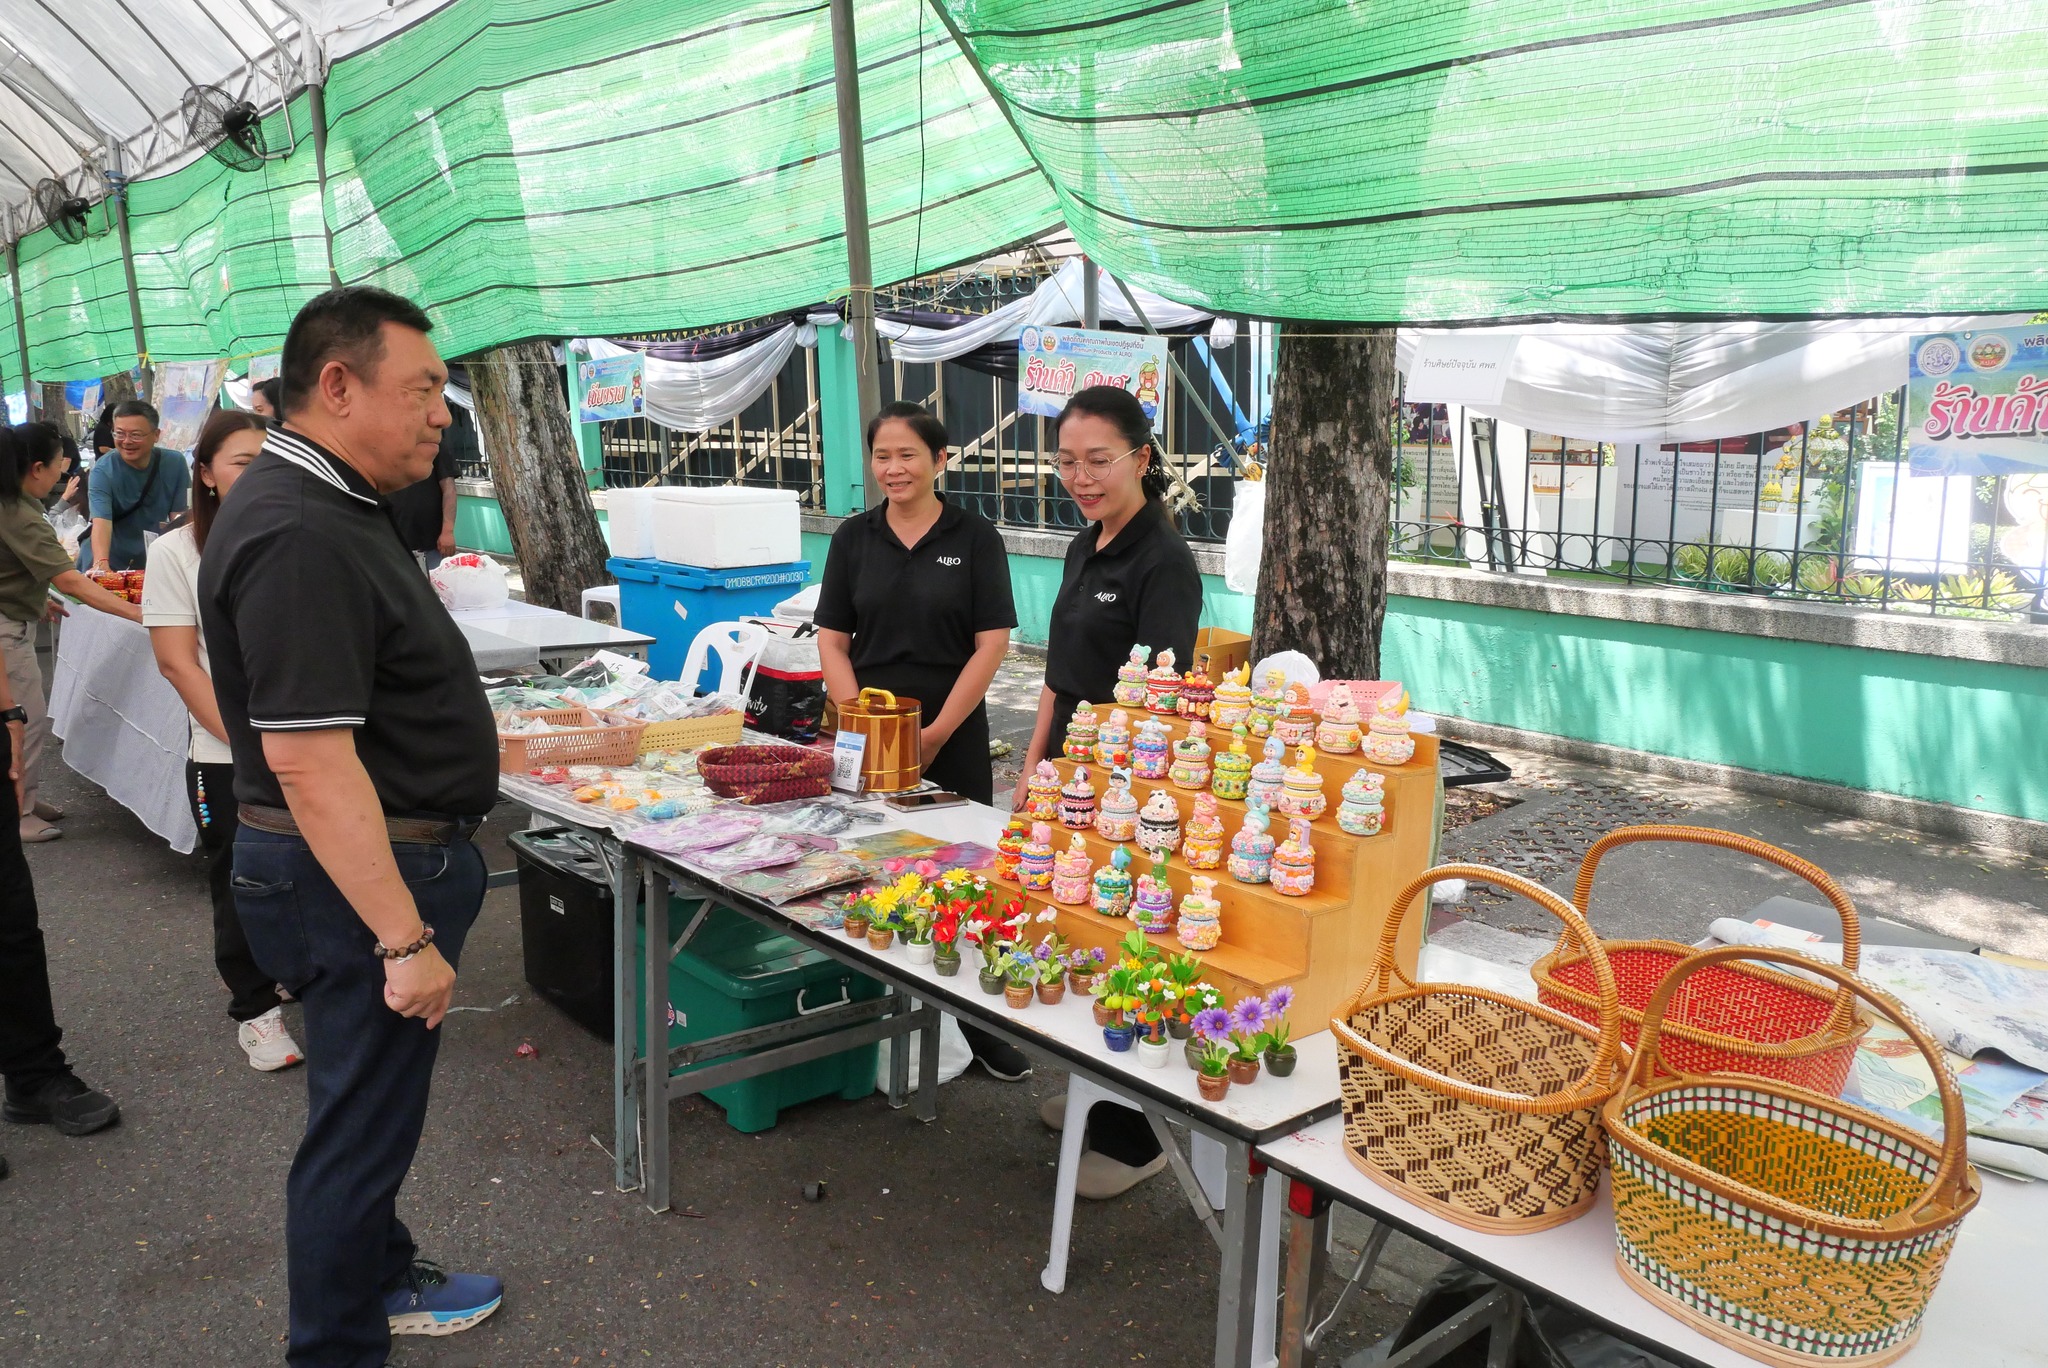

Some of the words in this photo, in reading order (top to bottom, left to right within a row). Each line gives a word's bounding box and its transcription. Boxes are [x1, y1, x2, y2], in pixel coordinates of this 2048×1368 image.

[1093, 348, 1112, 356] Products
[1423, 358, 1477, 371] ร้านศิษย์ปัจจุบัน
[1025, 355, 1075, 394] ร้านค้า
[588, 382, 626, 406] เชียงราย
[936, 556, 961, 566] ALRO
